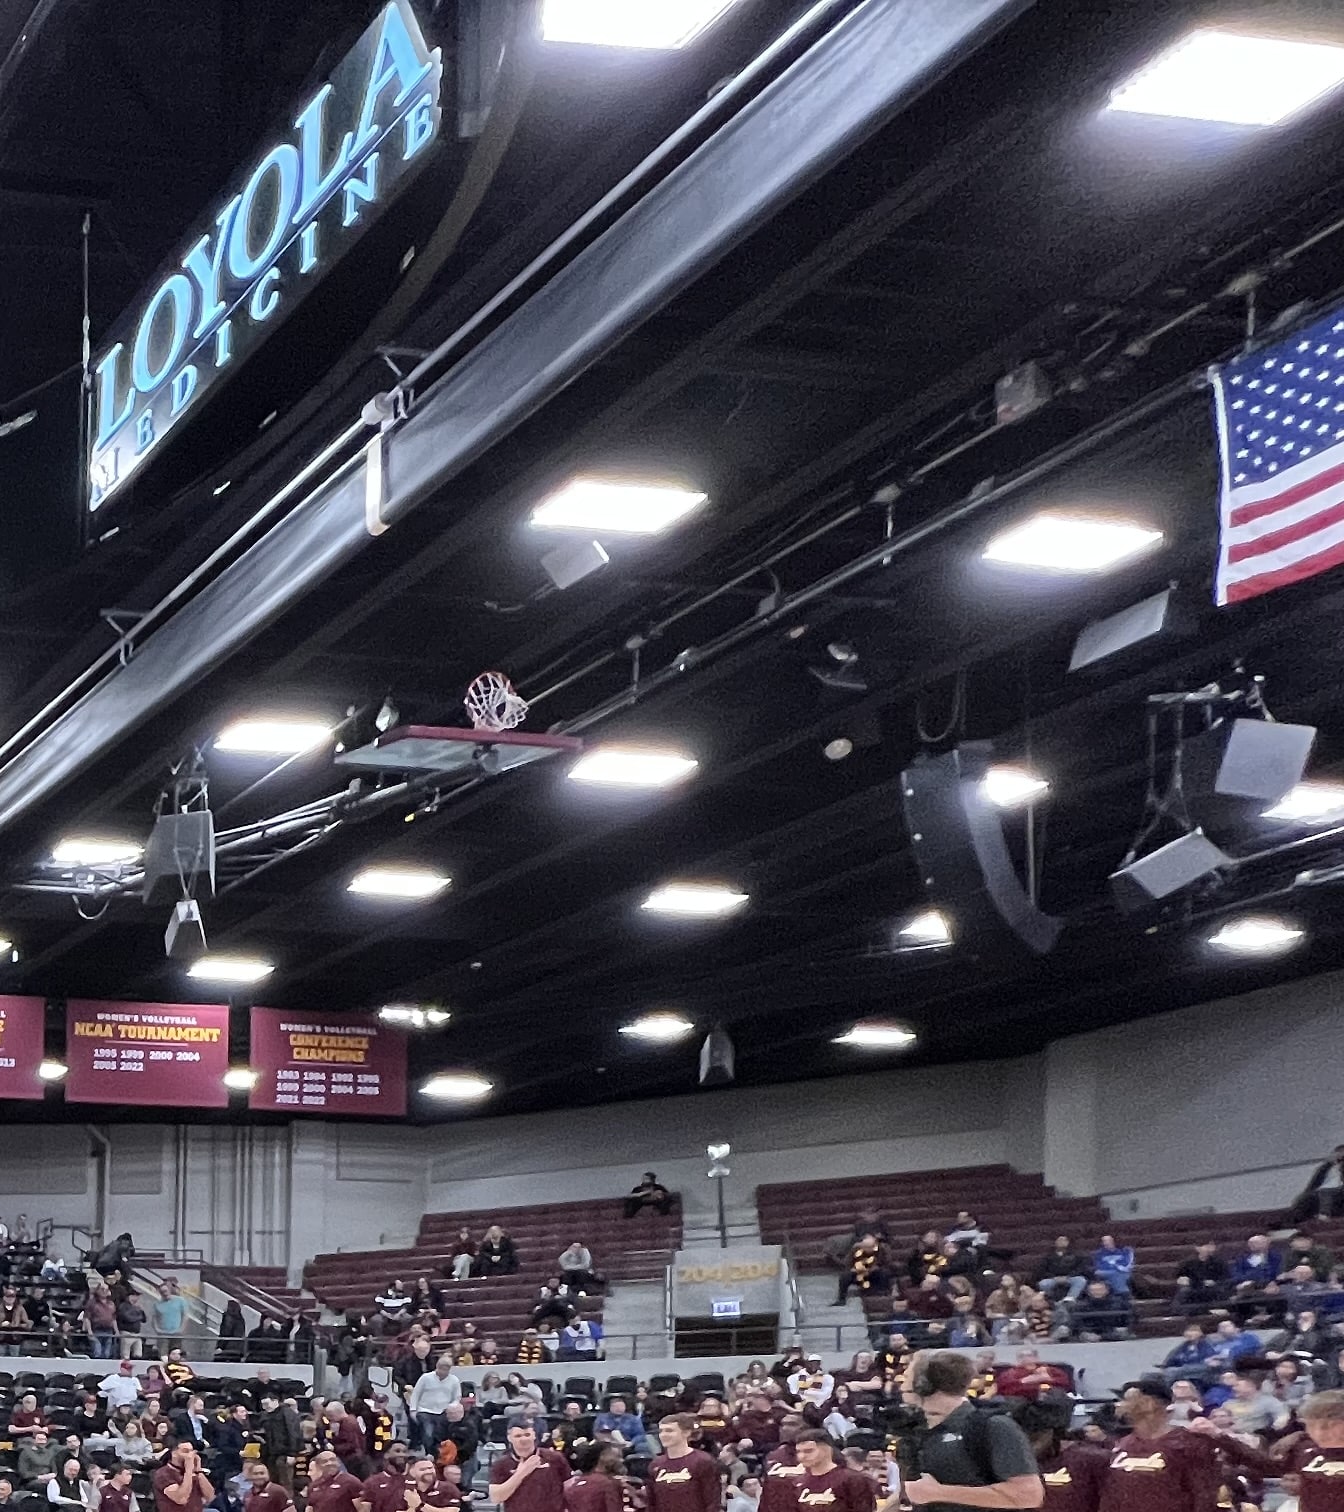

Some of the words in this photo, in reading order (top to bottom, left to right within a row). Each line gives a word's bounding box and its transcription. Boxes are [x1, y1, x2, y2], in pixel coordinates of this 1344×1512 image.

[96, 0, 434, 450] LOYOLA
[75, 1022, 113, 1037] NCAA
[118, 1025, 220, 1042] TOURNAMENT
